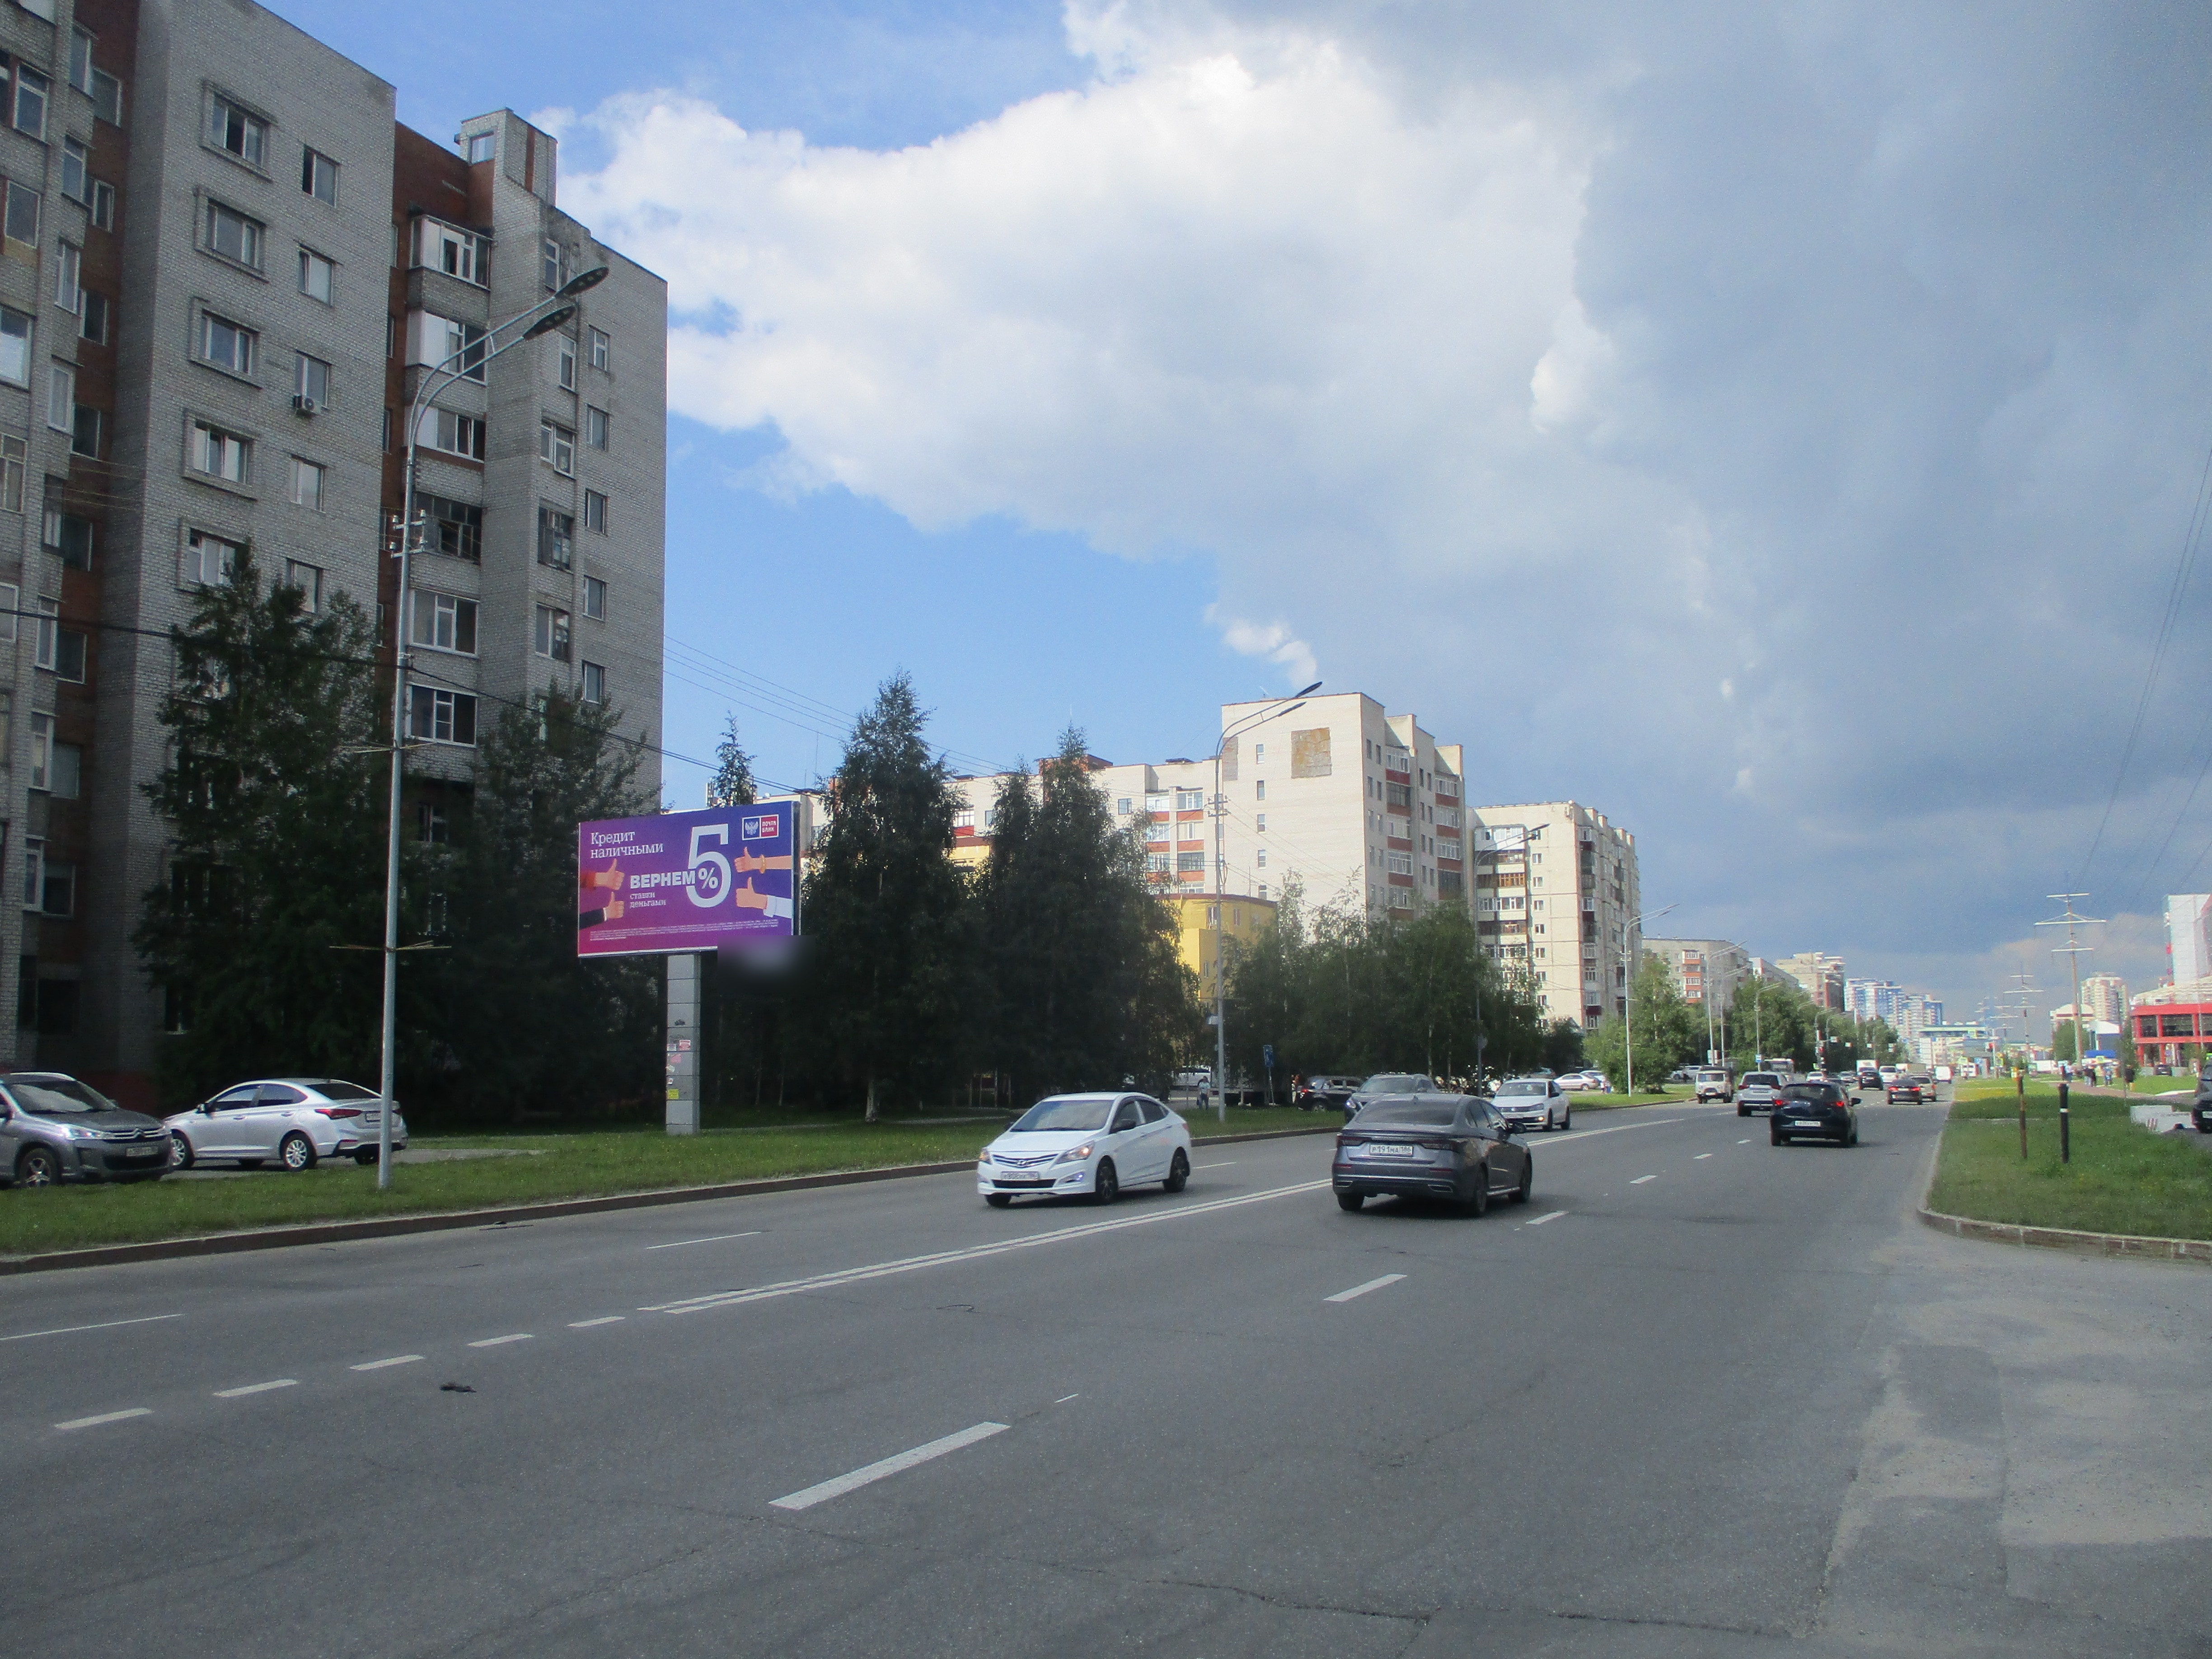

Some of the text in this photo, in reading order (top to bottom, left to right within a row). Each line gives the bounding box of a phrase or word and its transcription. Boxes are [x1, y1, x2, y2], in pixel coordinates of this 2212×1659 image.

[590, 832, 635, 847] Кредит
[590, 843, 664, 858] наличными
[686, 824, 731, 908] 5
[630, 871, 696, 889] ВЕРНЕМ
[629, 900, 666, 909] деньгами
